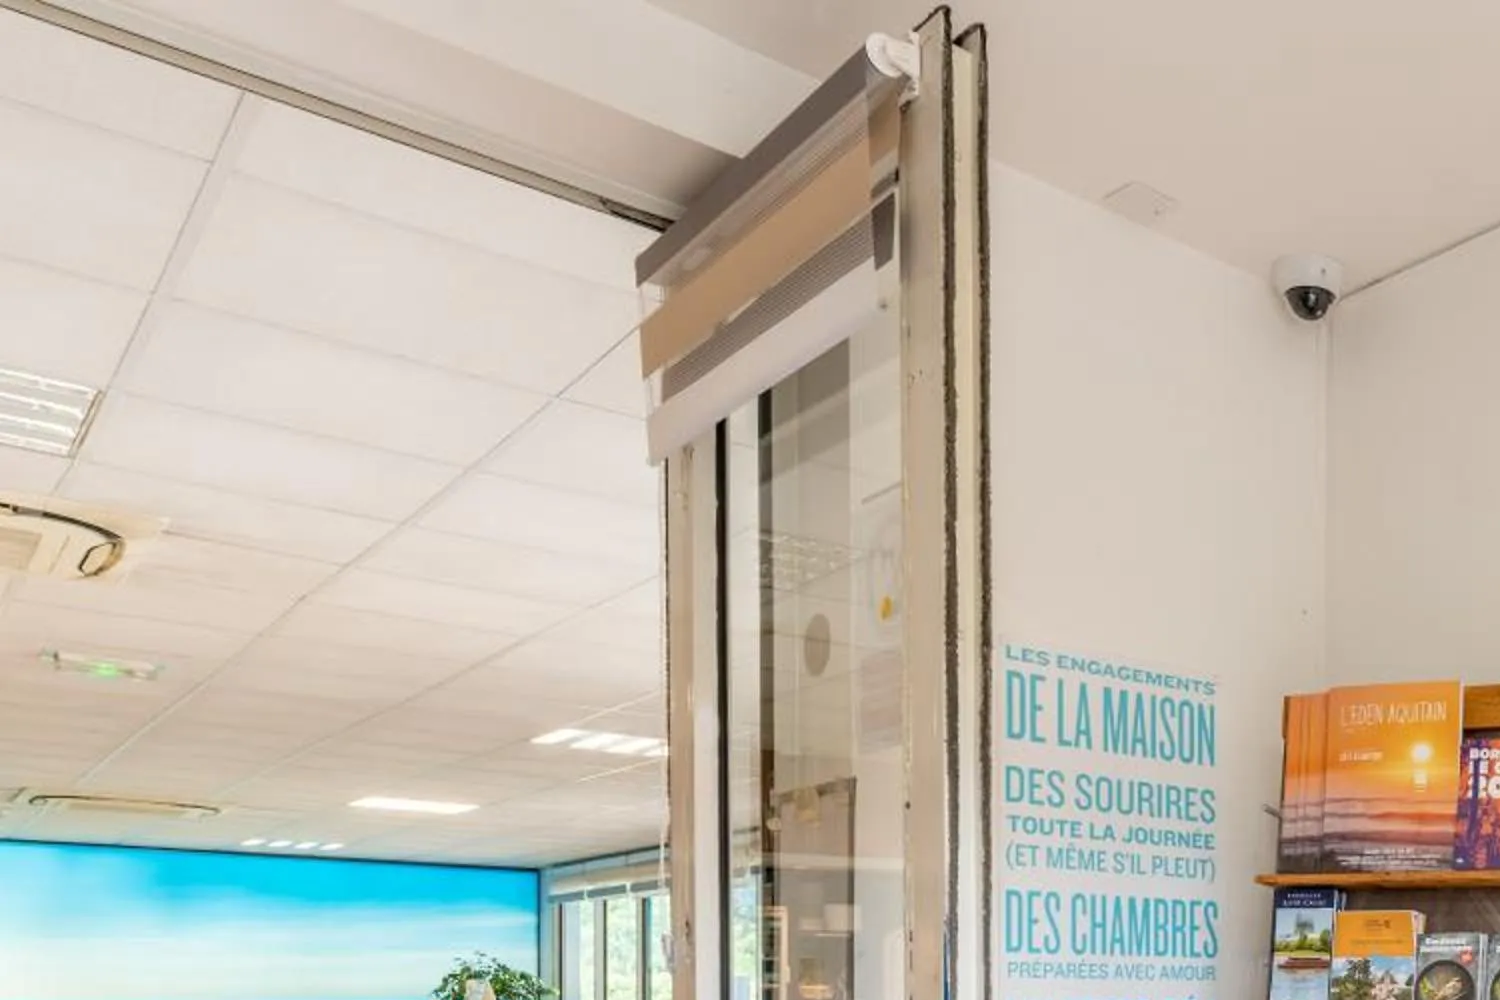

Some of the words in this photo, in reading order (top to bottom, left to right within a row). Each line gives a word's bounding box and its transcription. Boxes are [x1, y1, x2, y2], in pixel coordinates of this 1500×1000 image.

[1006, 644, 1050, 666] LES
[1057, 655, 1216, 695] ENGAGEMENTS
[1006, 669, 1046, 743] DE
[1058, 678, 1092, 750] LA
[1103, 687, 1215, 767] MAISON
[1005, 765, 1065, 808] DES
[1075, 773, 1216, 824] SOURIRES
[1006, 815, 1082, 838] TOUTE
[1089, 822, 1116, 841] LA
[1122, 826, 1215, 850] JOURNÉE
[1006, 840, 1039, 870] (ET
[1047, 842, 1106, 871] MÊME
[1113, 853, 1146, 875] S'IL
[1152, 855, 1216, 882] PLEUT)
[1005, 889, 1061, 955] DES
[1071, 893, 1218, 959] CHAMBRES
[1114, 963, 1155, 981] AVEC
[1160, 965, 1216, 981] AMOUR
